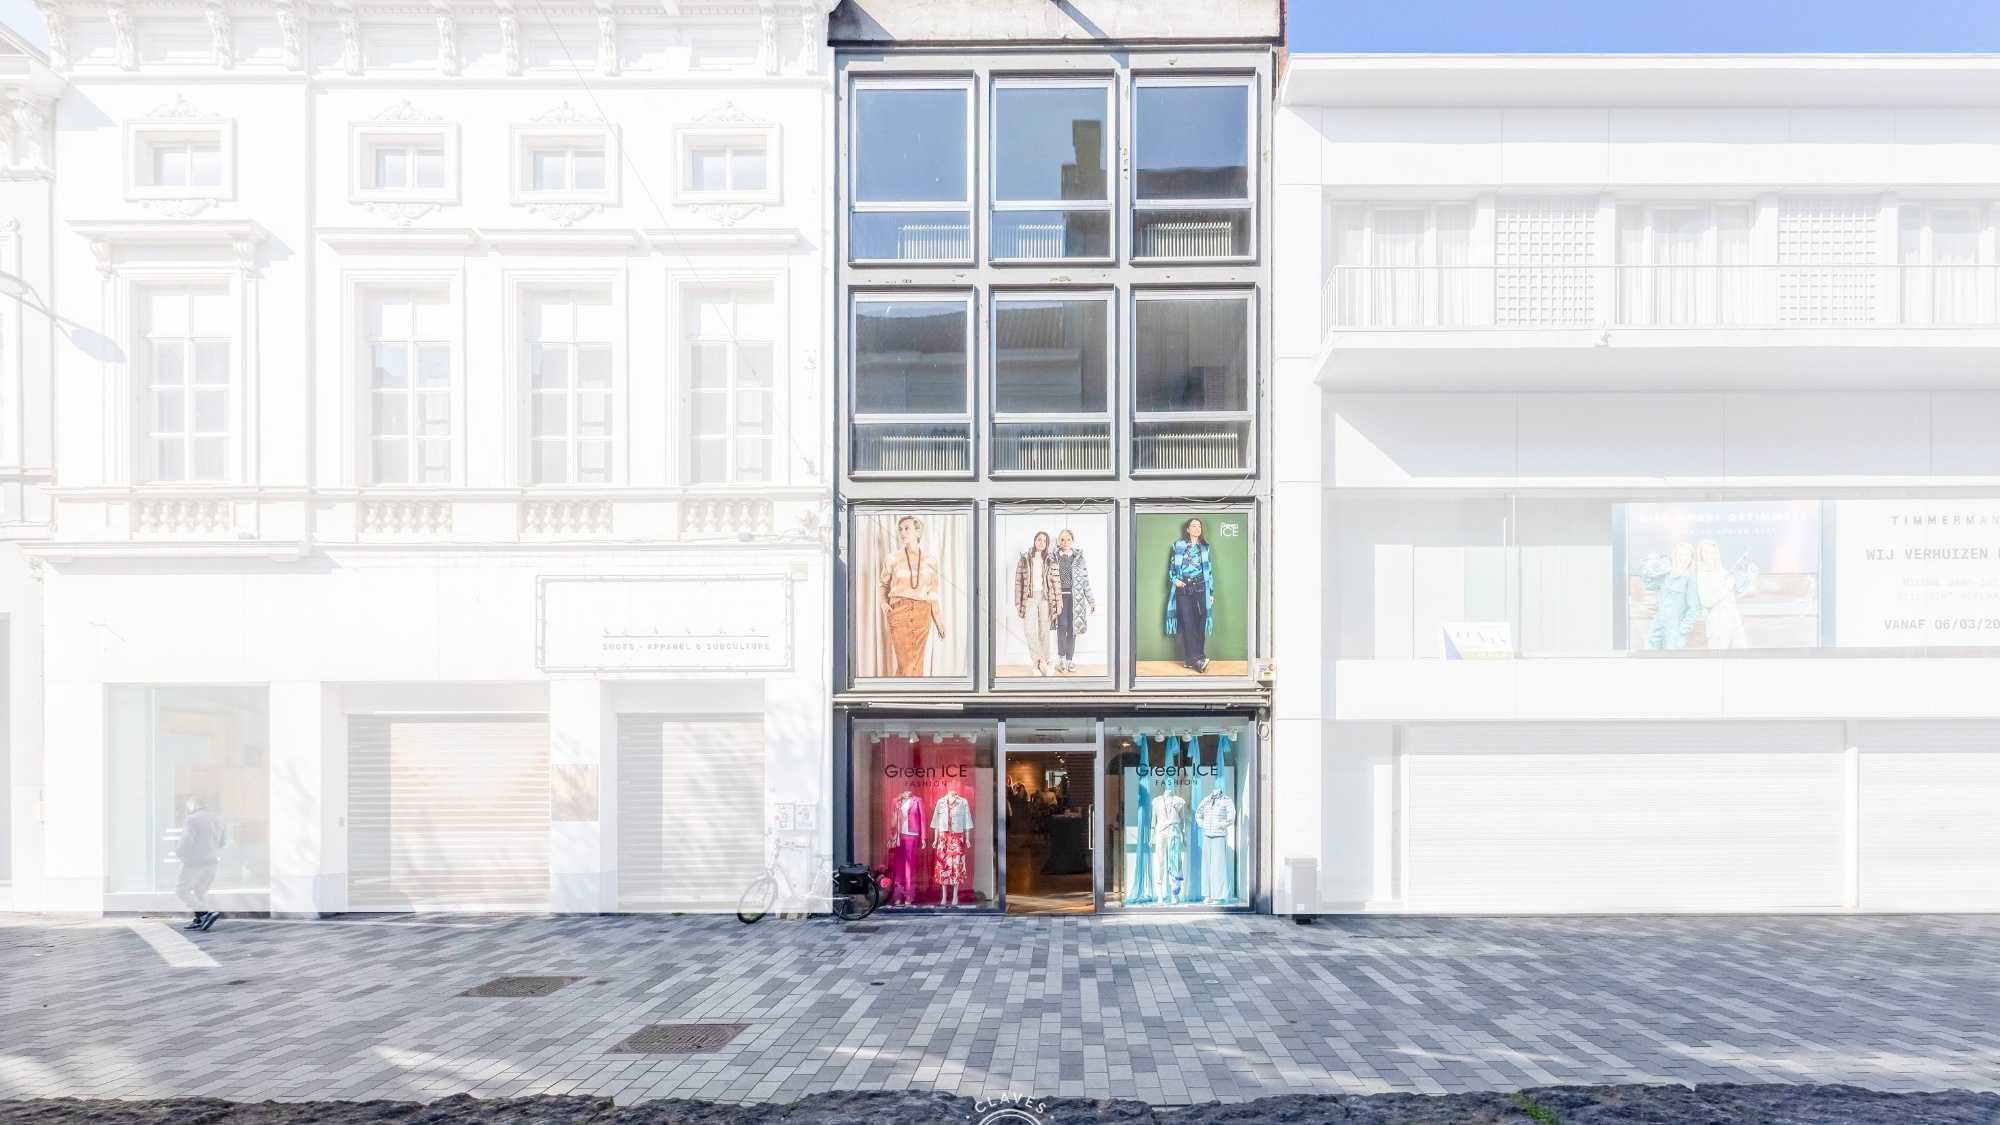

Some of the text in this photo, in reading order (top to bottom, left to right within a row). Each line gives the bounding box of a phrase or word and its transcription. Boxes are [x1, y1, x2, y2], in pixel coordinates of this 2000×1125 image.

[1891, 515, 2000, 525] TIMMERMAN
[1220, 528, 1239, 537] ICE
[1866, 548, 1894, 560] WIJ
[1904, 548, 1989, 560] VERHUIZEN
[1902, 577, 1941, 587] NIEUWE
[1884, 618, 2000, 631] VANAF 06/03/20
[602, 643, 634, 651] SHOES
[706, 642, 770, 650] SUBCULTURE
[884, 764, 968, 778] Green ICE
[1136, 763, 1218, 777] Green ICE
